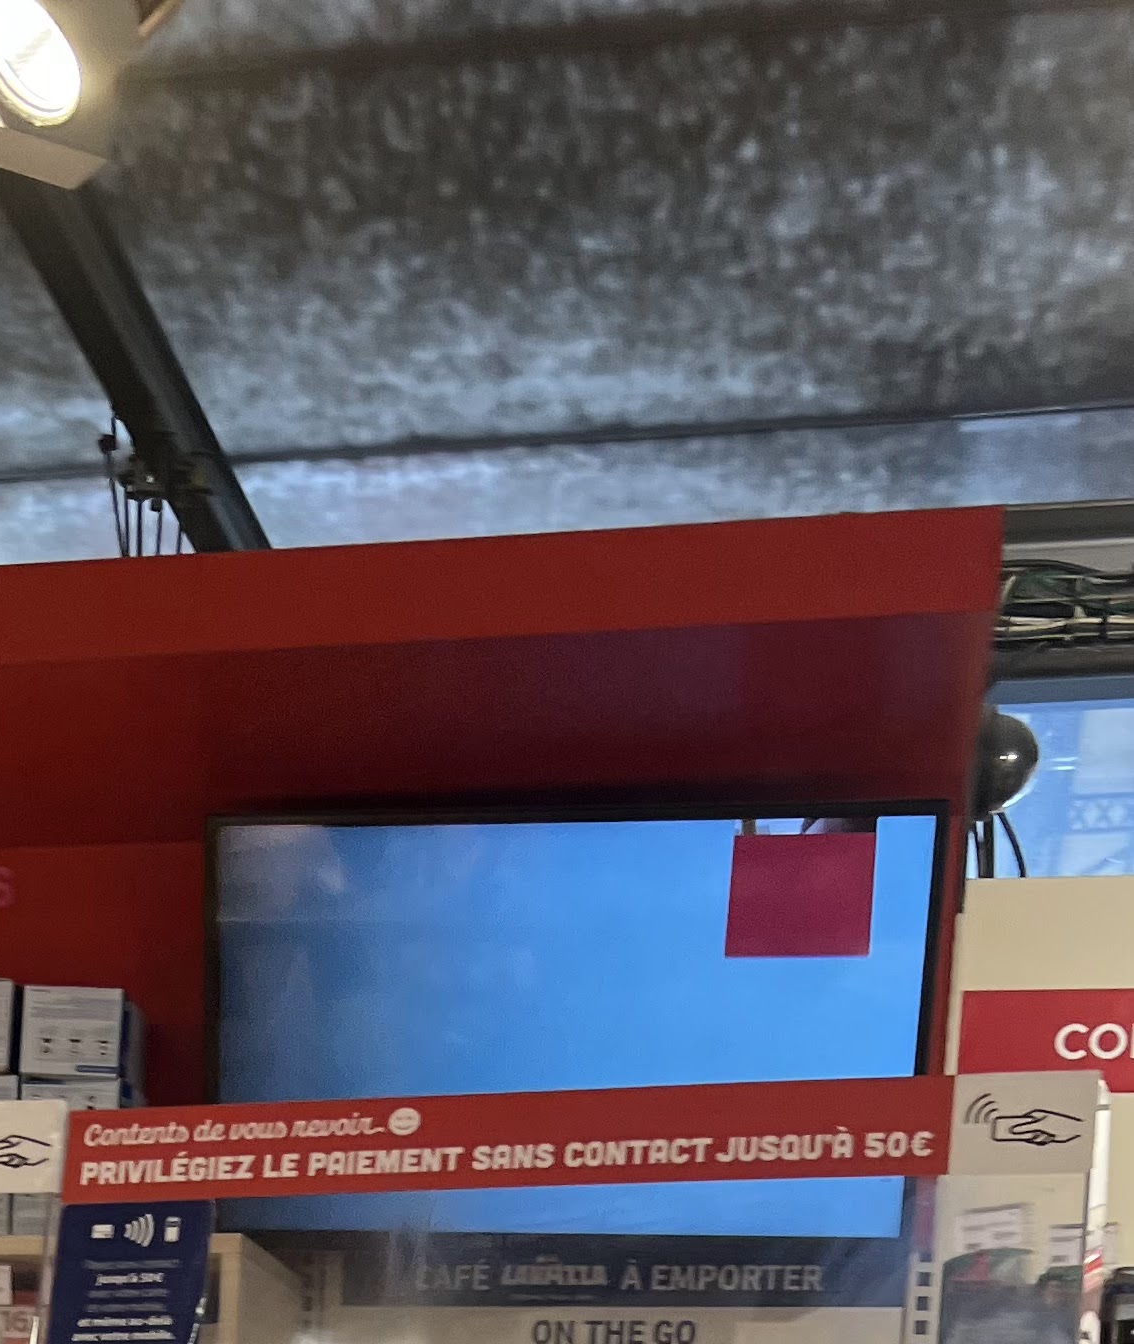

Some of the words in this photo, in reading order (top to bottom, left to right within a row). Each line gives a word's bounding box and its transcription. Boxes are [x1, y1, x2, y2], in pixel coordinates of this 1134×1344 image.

[1053, 1022, 1134, 1060] CO
[193, 1117, 226, 1145] de
[229, 1119, 287, 1141] vous
[79, 1150, 254, 1186] PRIVILÉGIEZ
[263, 1152, 300, 1179] LE
[307, 1146, 464, 1177] PAIEMENT
[472, 1142, 555, 1171] SANS
[564, 1136, 714, 1169] CONTACT
[716, 1126, 854, 1164] JUSQU'À
[863, 1131, 935, 1159] 50€
[414, 1258, 491, 1292] CAFÉ
[619, 1257, 644, 1291] À
[650, 1263, 826, 1293] EMPORTER
